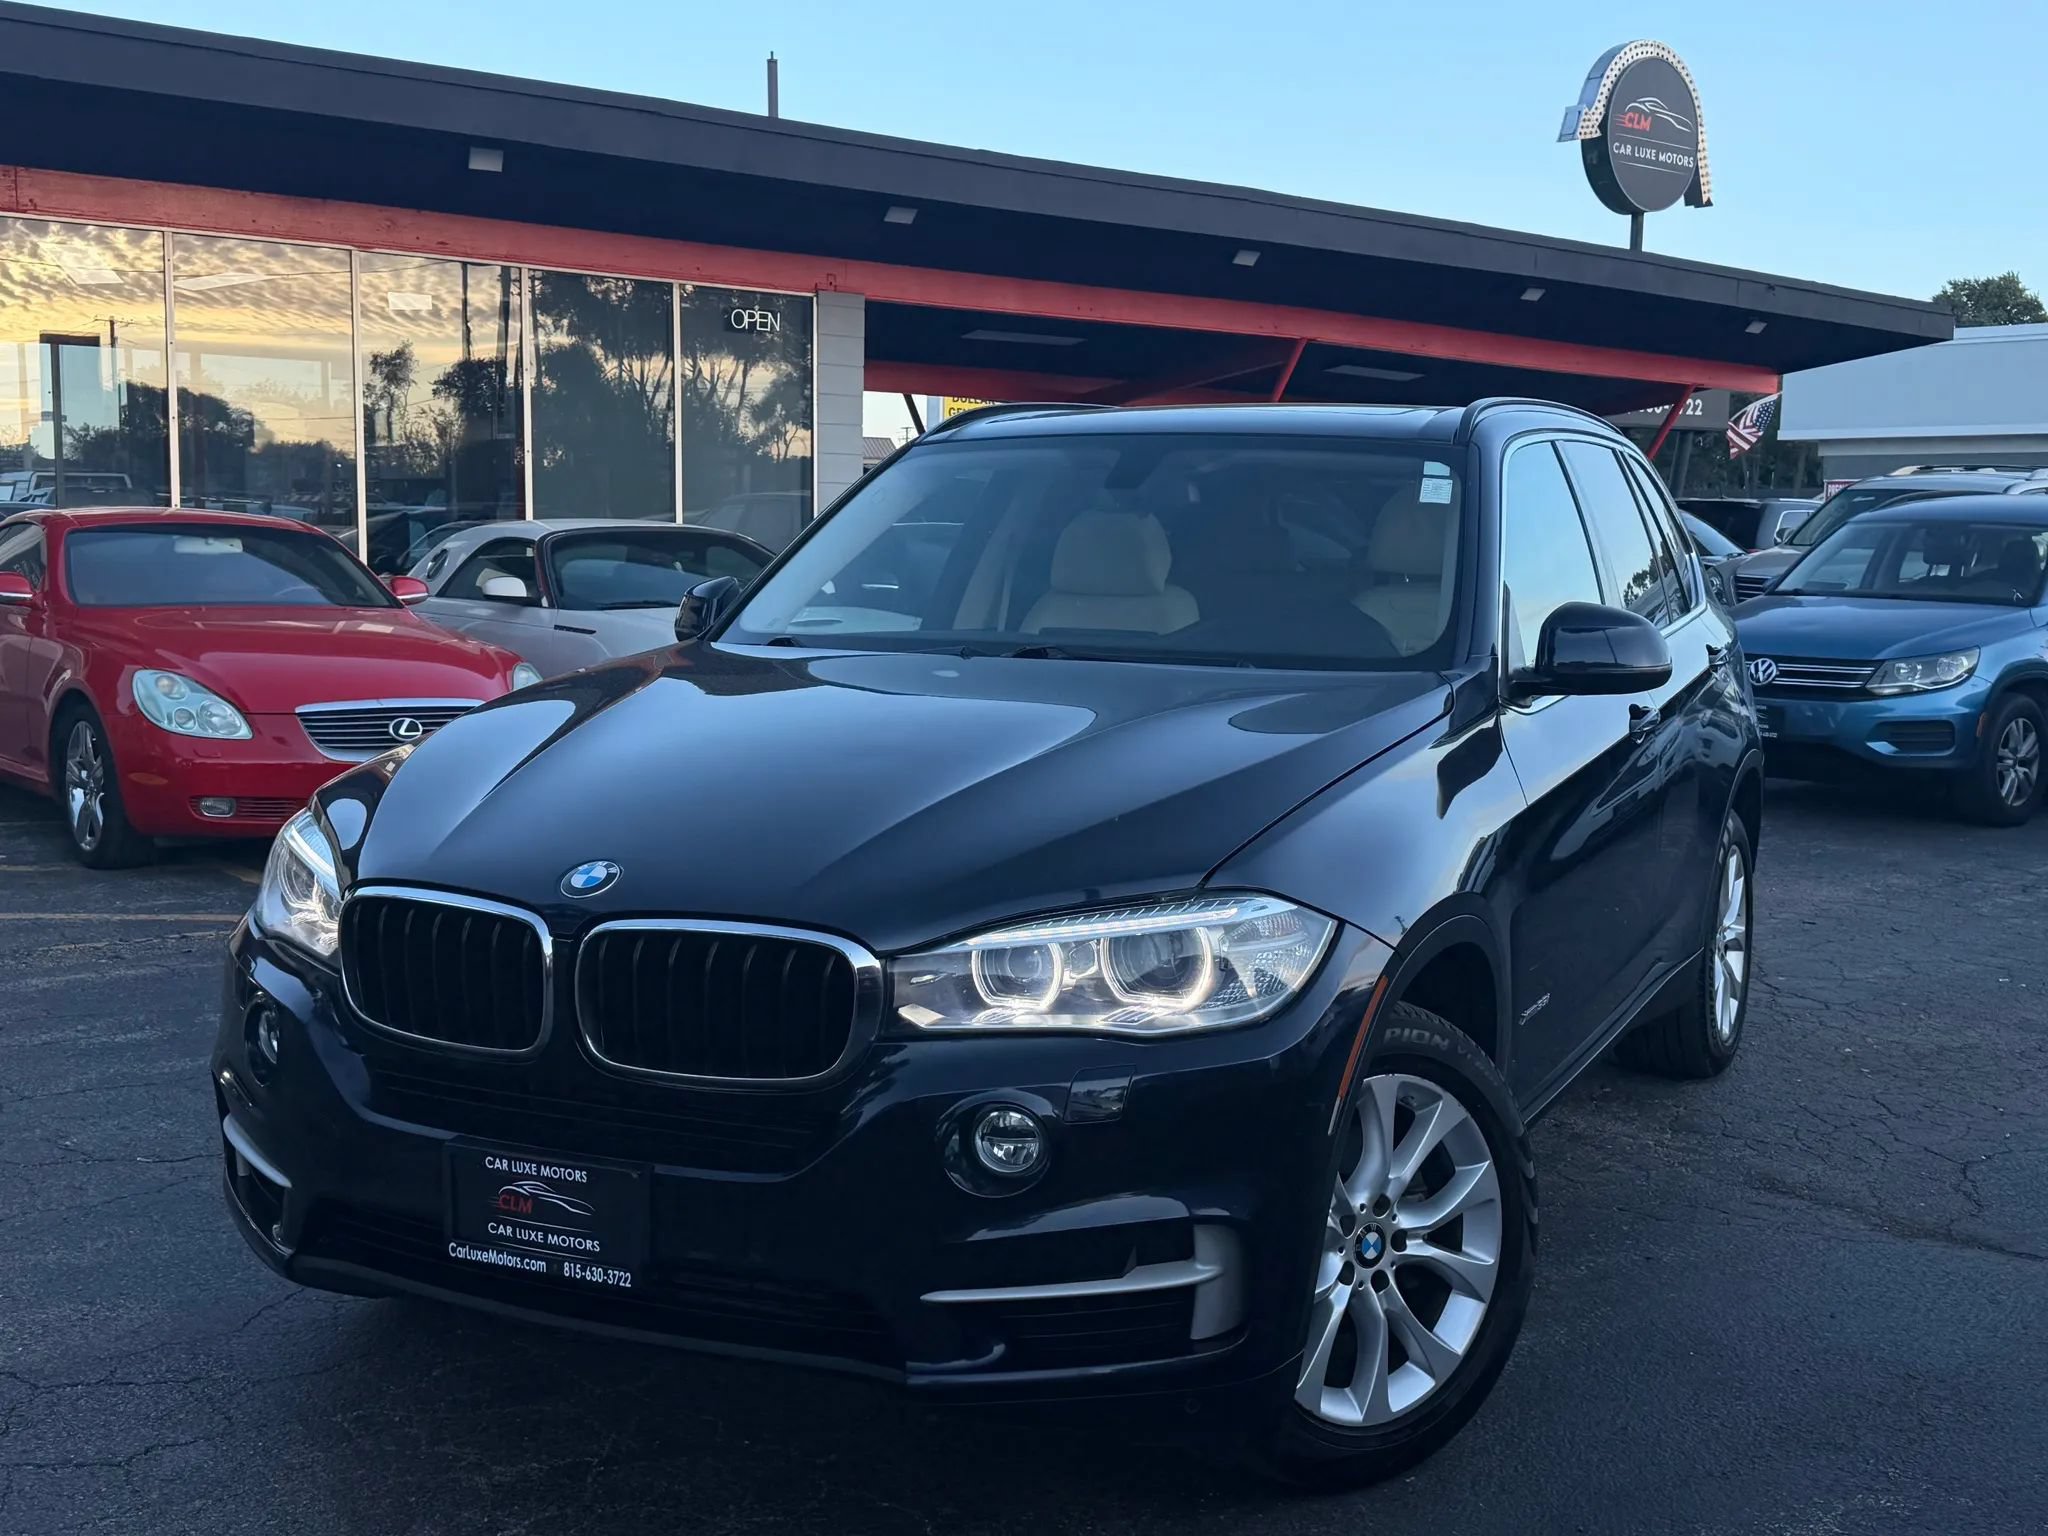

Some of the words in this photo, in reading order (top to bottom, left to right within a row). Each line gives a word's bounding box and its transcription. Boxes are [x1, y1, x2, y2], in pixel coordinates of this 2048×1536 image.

[1624, 112, 1652, 131] CLM
[1613, 142, 1632, 156] CAR
[1635, 146, 1656, 160] LUXE
[1658, 151, 1694, 168] MOTORS
[731, 308, 781, 332] OPEN
[485, 1156, 508, 1171] CAR
[511, 1159, 537, 1175] LUXE
[540, 1164, 588, 1183] MOTORS
[498, 1195, 533, 1214] CLM
[488, 1222, 513, 1238] CAR
[516, 1227, 544, 1243] LUXE
[547, 1233, 600, 1252] MOTORS
[448, 1242, 547, 1273] CarLuxeMotors.com
[563, 1262, 631, 1288] 815-630-3722
